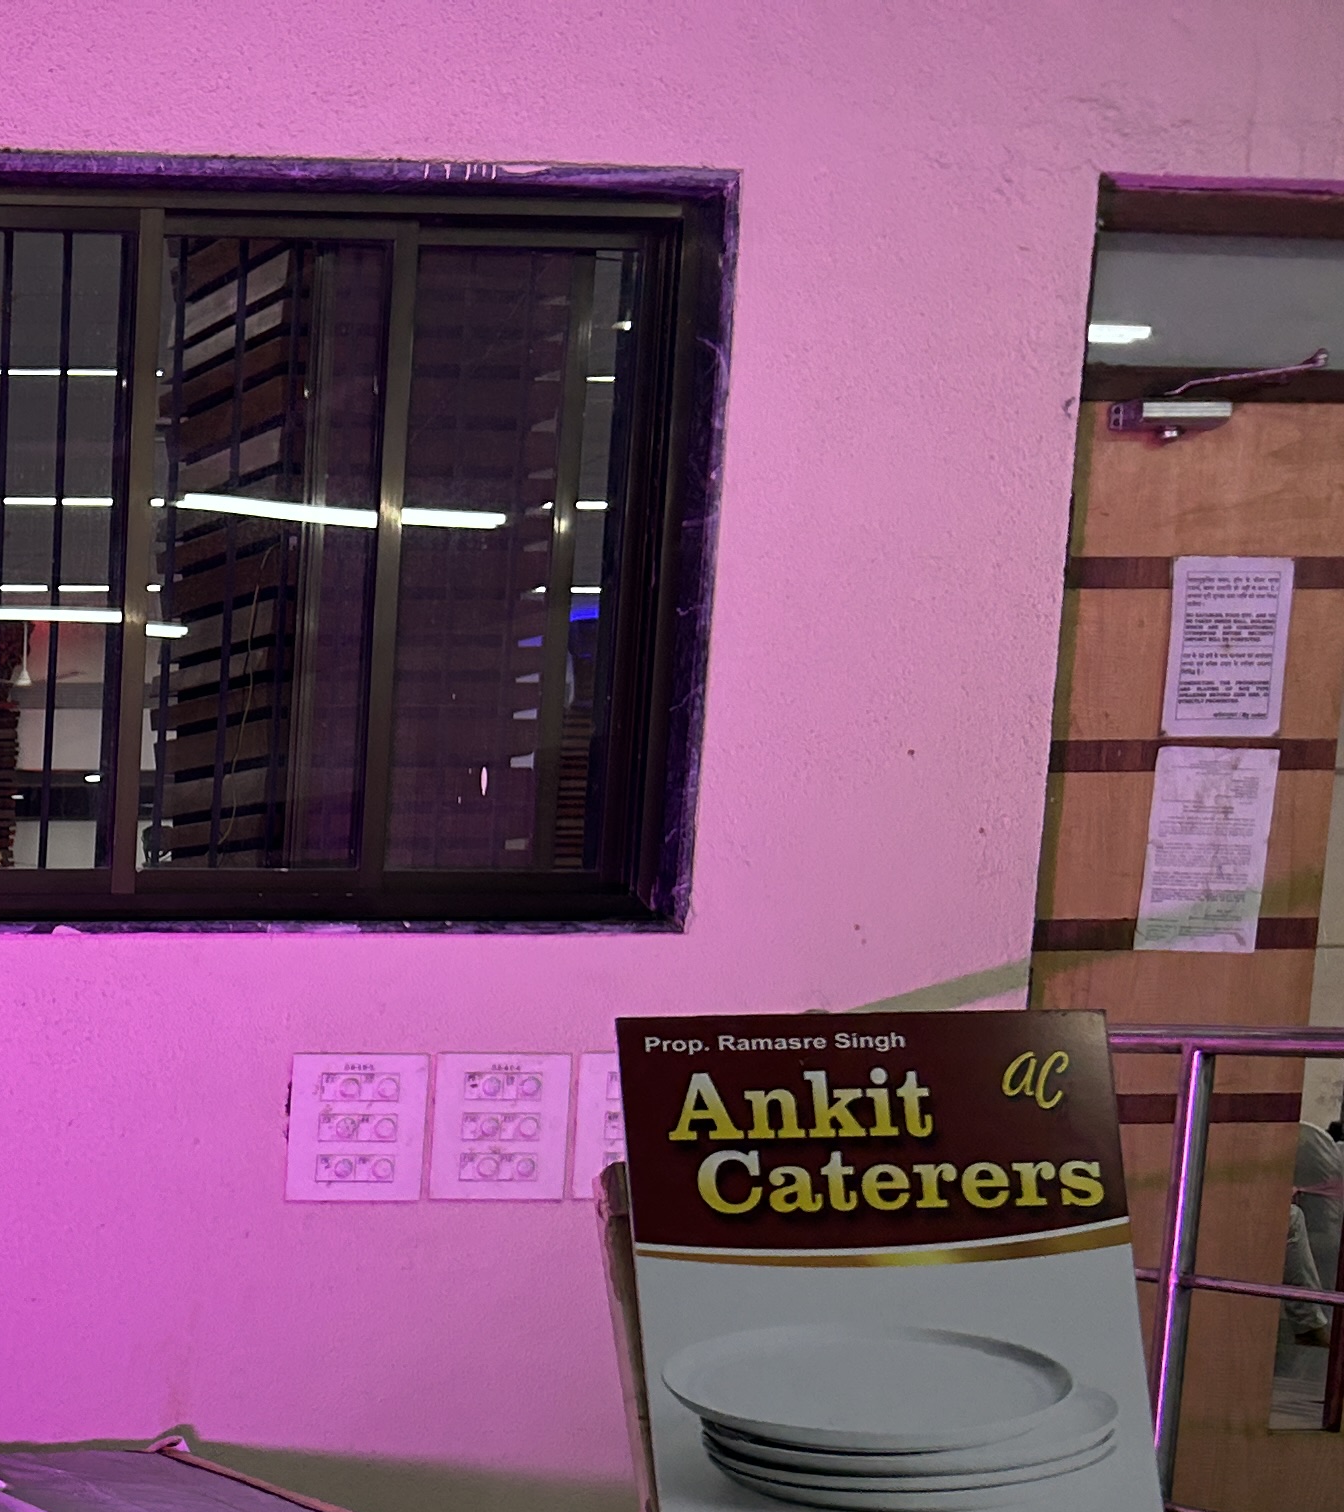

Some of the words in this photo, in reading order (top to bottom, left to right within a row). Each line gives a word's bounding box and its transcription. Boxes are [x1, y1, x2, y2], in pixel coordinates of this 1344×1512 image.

[644, 1036, 709, 1055] Prop.
[718, 1033, 827, 1052] Ramasre
[834, 1031, 906, 1051] Singh
[668, 1066, 934, 1141] Ankit
[696, 1148, 1105, 1215] Caterers
